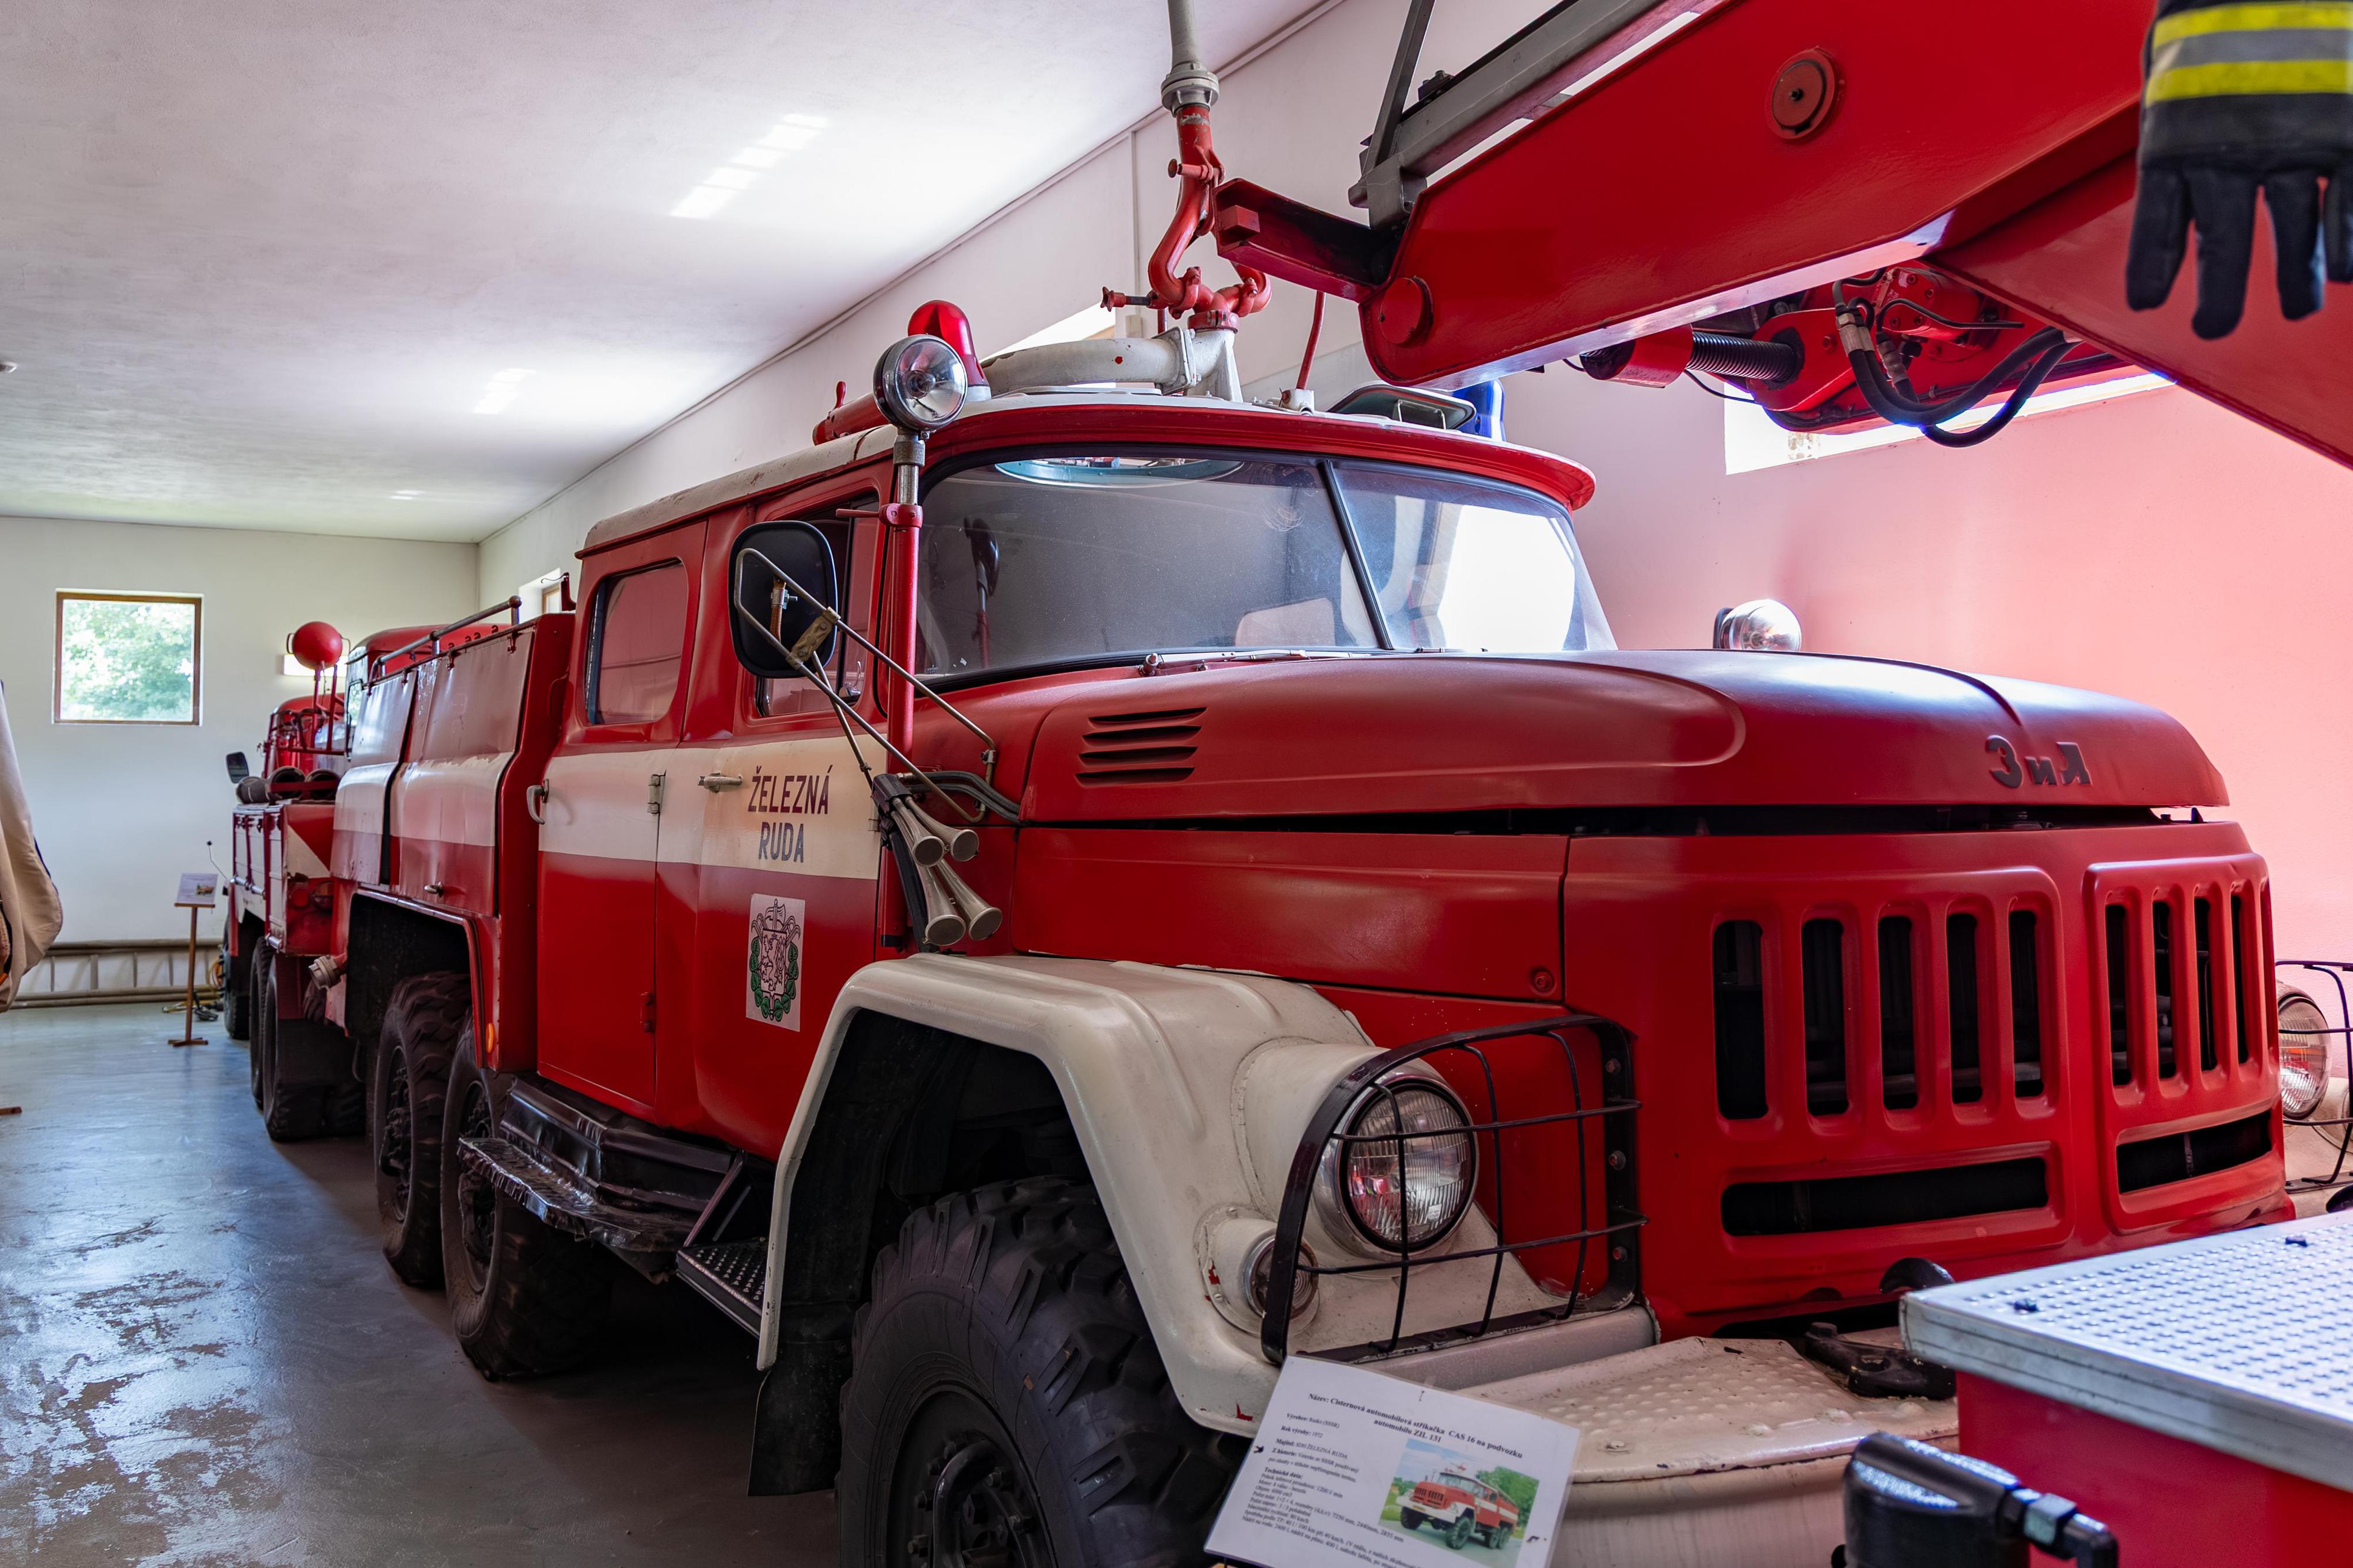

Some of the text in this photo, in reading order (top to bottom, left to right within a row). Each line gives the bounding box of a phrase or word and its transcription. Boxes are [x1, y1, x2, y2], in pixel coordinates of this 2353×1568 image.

[748, 765, 833, 814] ŽELEZNÁ
[758, 822, 804, 863] RUDA
[1308, 1393, 1329, 1403] Název:
[1366, 1409, 1412, 1424] automobilová
[1487, 1443, 1523, 1458] podvozku
[1374, 1420, 1412, 1434] automobilu
[1307, 1443, 1331, 1454] ŽELEZNÁ
[1331, 1450, 1348, 1459] RUDA
